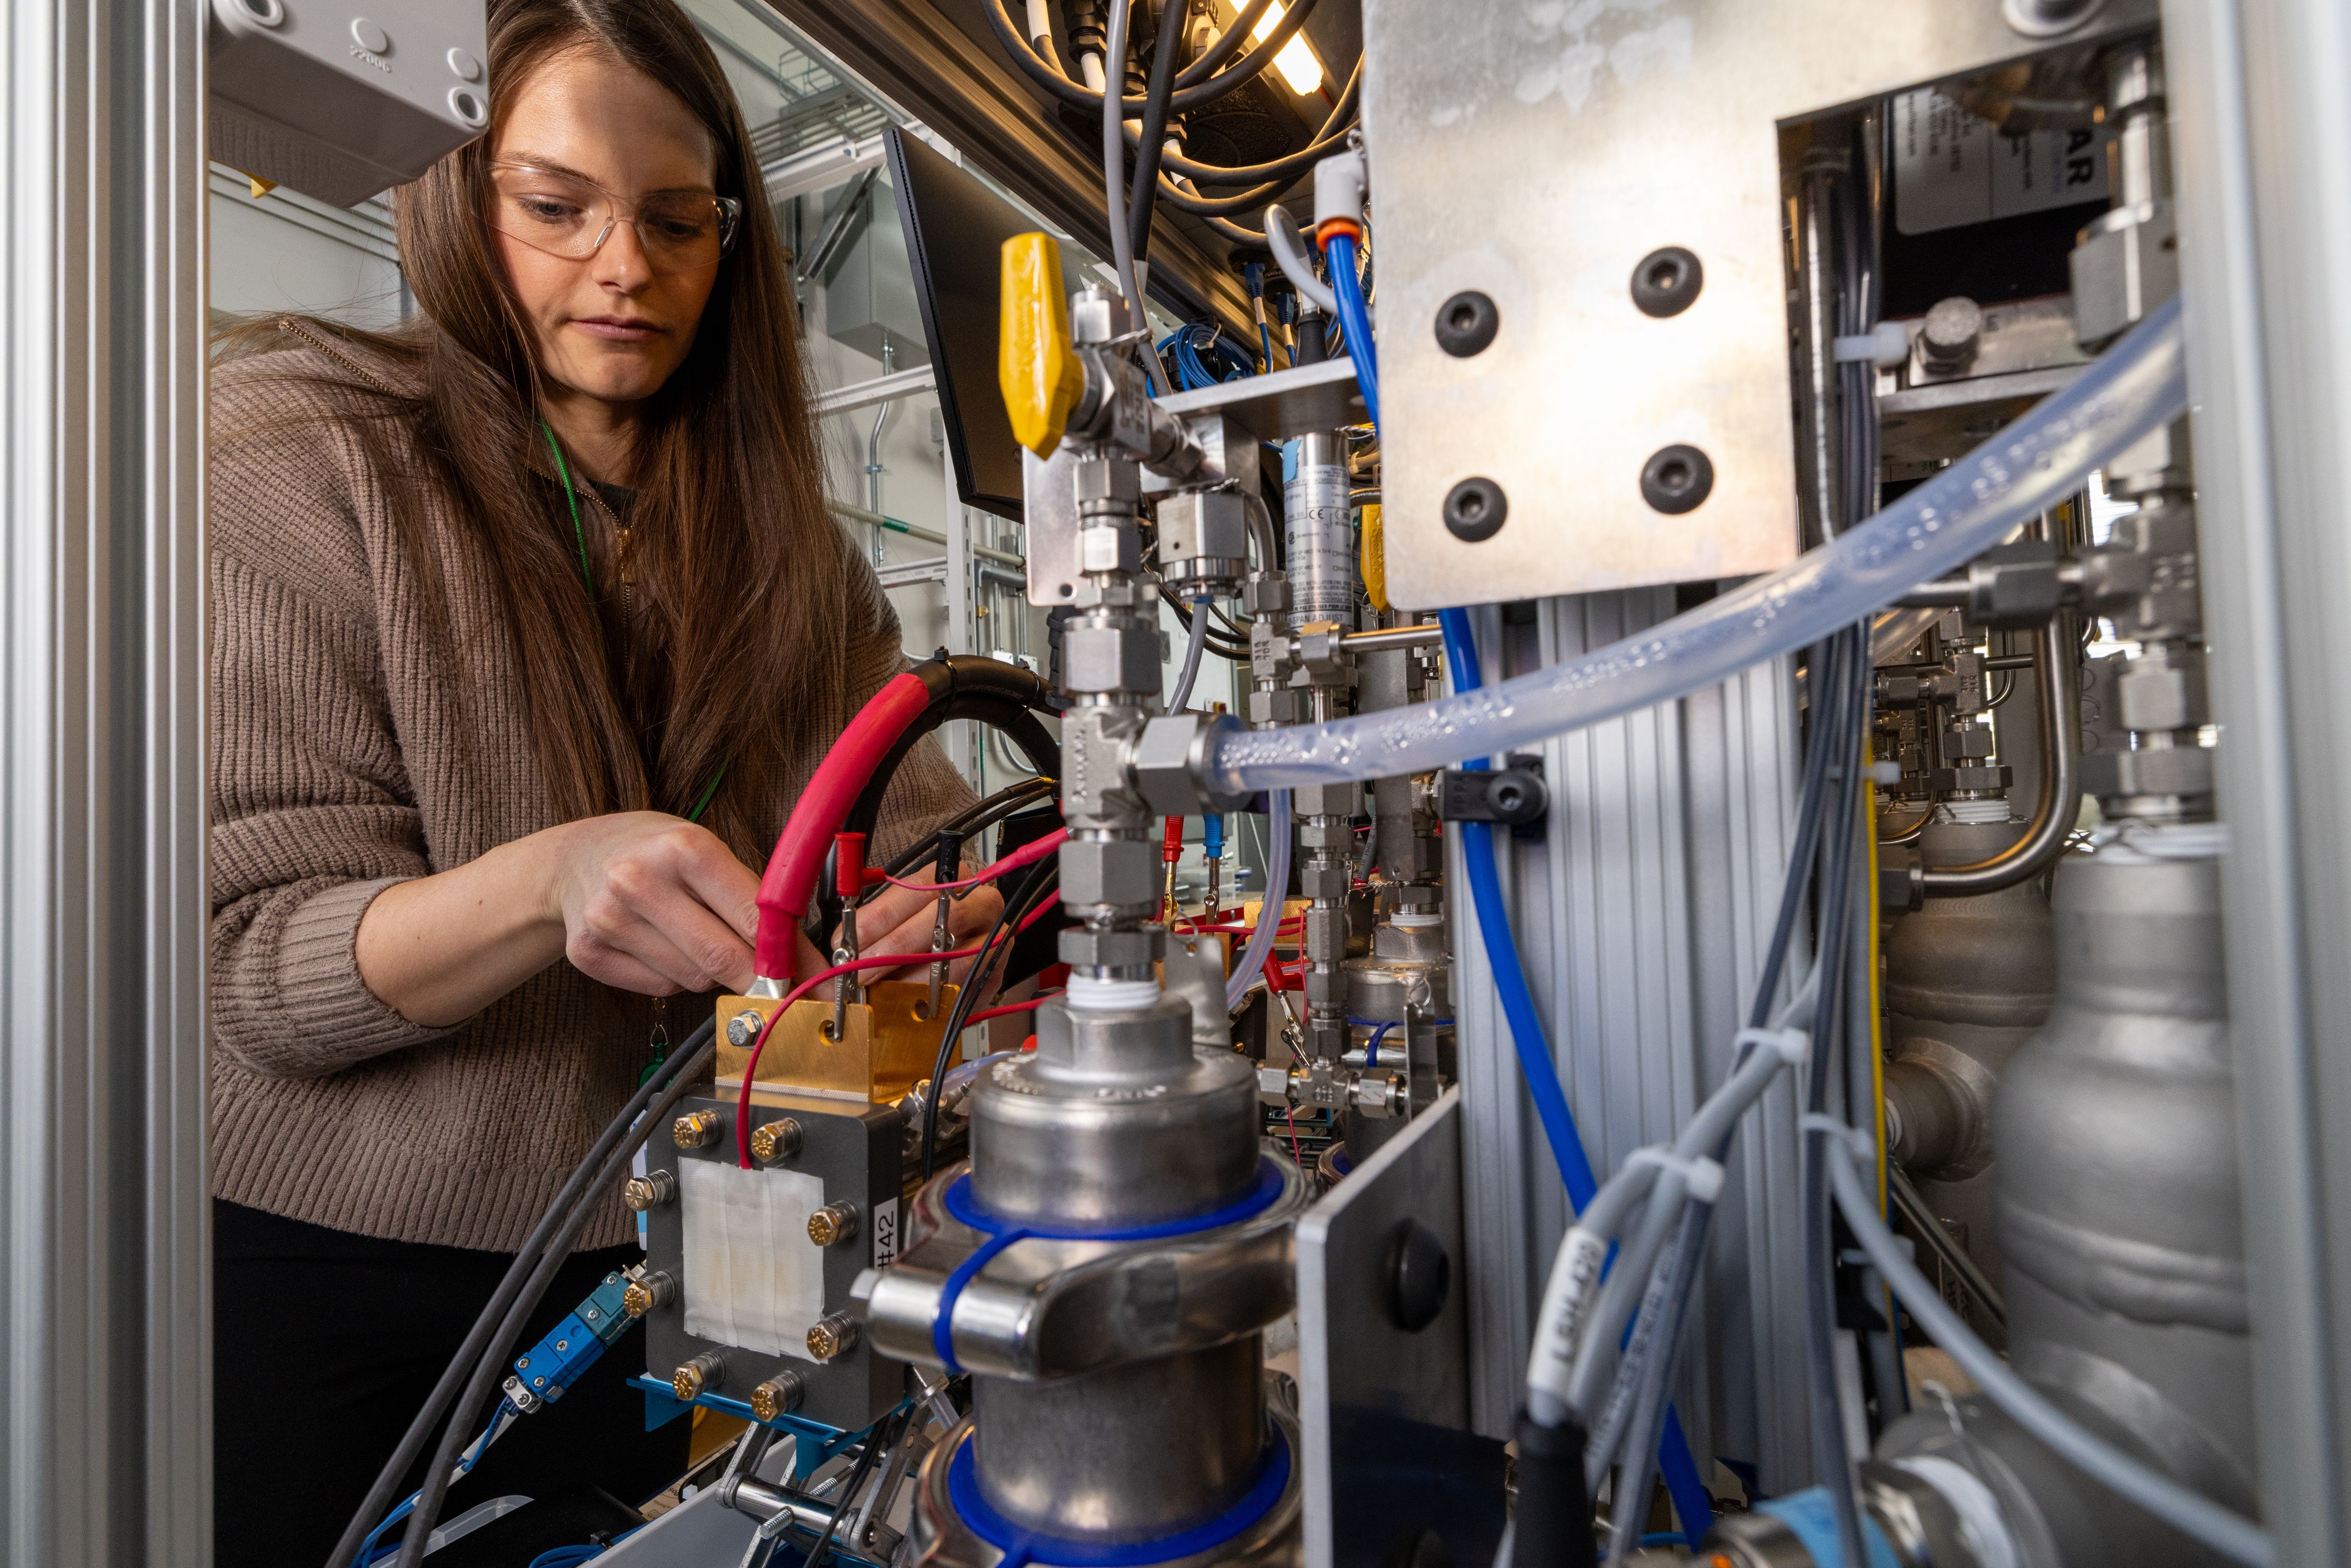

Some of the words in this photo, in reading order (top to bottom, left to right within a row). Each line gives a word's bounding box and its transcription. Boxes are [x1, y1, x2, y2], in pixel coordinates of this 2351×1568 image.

[1309, 509, 1324, 520] CE
[1312, 614, 1343, 622] ADJUST
[877, 1210, 894, 1271] #42
